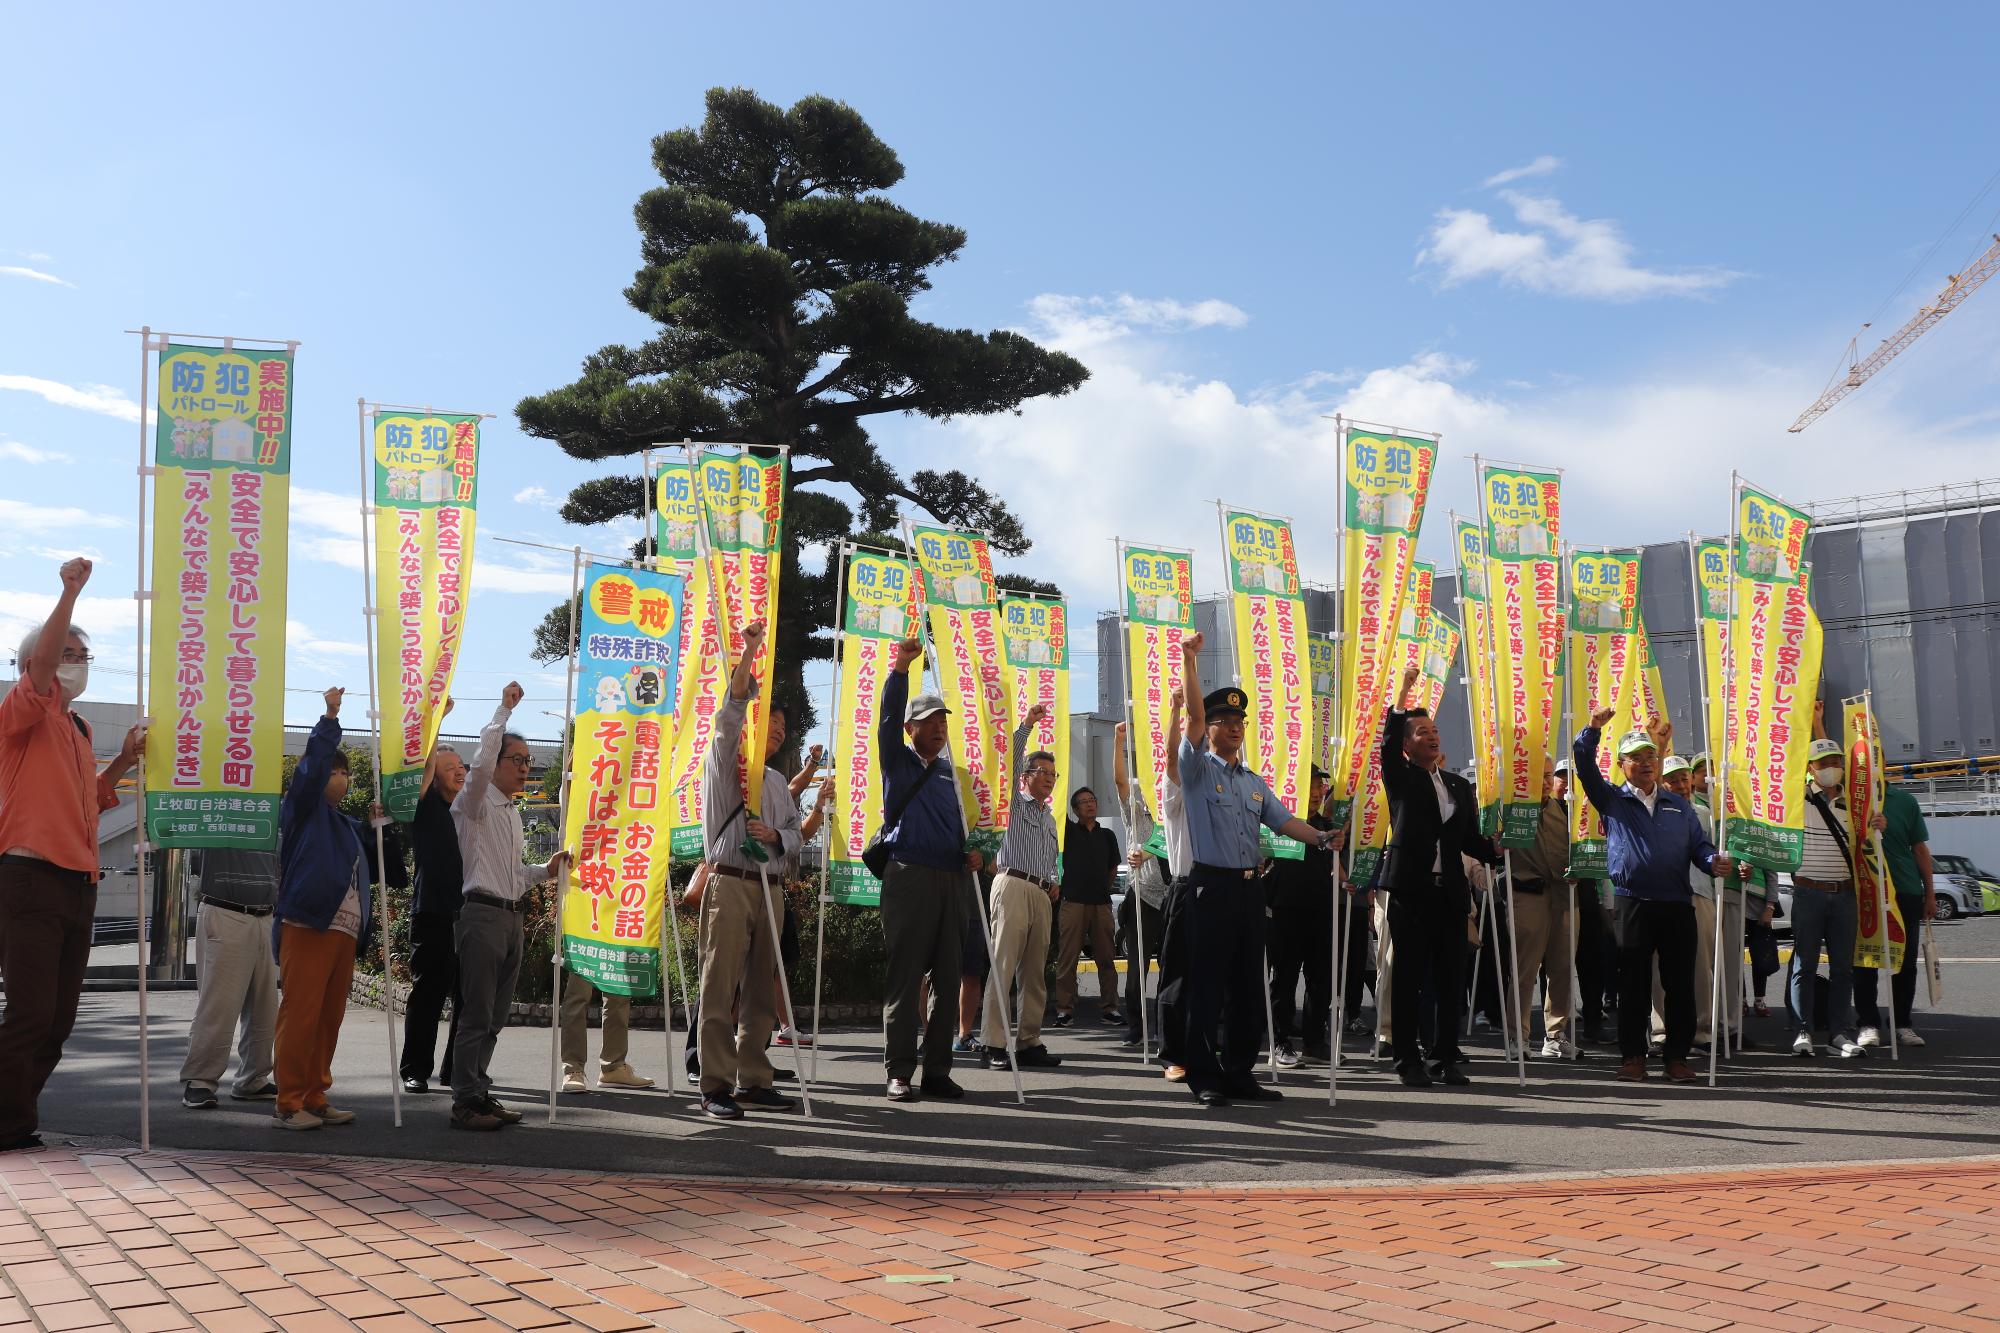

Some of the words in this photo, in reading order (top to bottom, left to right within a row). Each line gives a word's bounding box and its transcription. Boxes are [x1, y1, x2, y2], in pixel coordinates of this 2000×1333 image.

[172, 361, 250, 396] 防犯
[171, 395, 250, 414] パトロール
[386, 424, 447, 451] 防犯
[385, 450, 448, 465] パトロール
[1355, 443, 1411, 474] 防犯
[706, 465, 761, 493] 防犯
[1356, 473, 1412, 489] パトロール
[709, 494, 760, 507] パトロール
[1492, 481, 1538, 506] 防犯
[1493, 507, 1540, 519] パトロール
[1235, 523, 1276, 550] 防犯
[921, 537, 971, 561] 防犯
[1236, 546, 1278, 561] パトロール
[857, 562, 903, 591] 防犯
[928, 559, 974, 573] パトロール
[1132, 558, 1174, 581] 防犯
[1578, 563, 1620, 585] 防犯
[855, 586, 903, 603] パトロール
[1133, 580, 1175, 591] パトロール
[599, 581, 670, 631] 警戒
[1007, 605, 1045, 627] 防犯
[174, 471, 211, 786] 「みんなで築こう安心かんまき」
[223, 472, 261, 787] 安全で安心して暮らせる町
[1007, 627, 1046, 637] パトロール
[589, 635, 672, 665] 特殊詐欺
[153, 798, 271, 813] 上牧町自治連合会
[202, 814, 224, 823] 協力
[568, 941, 651, 964] 上牧町自治連合会
